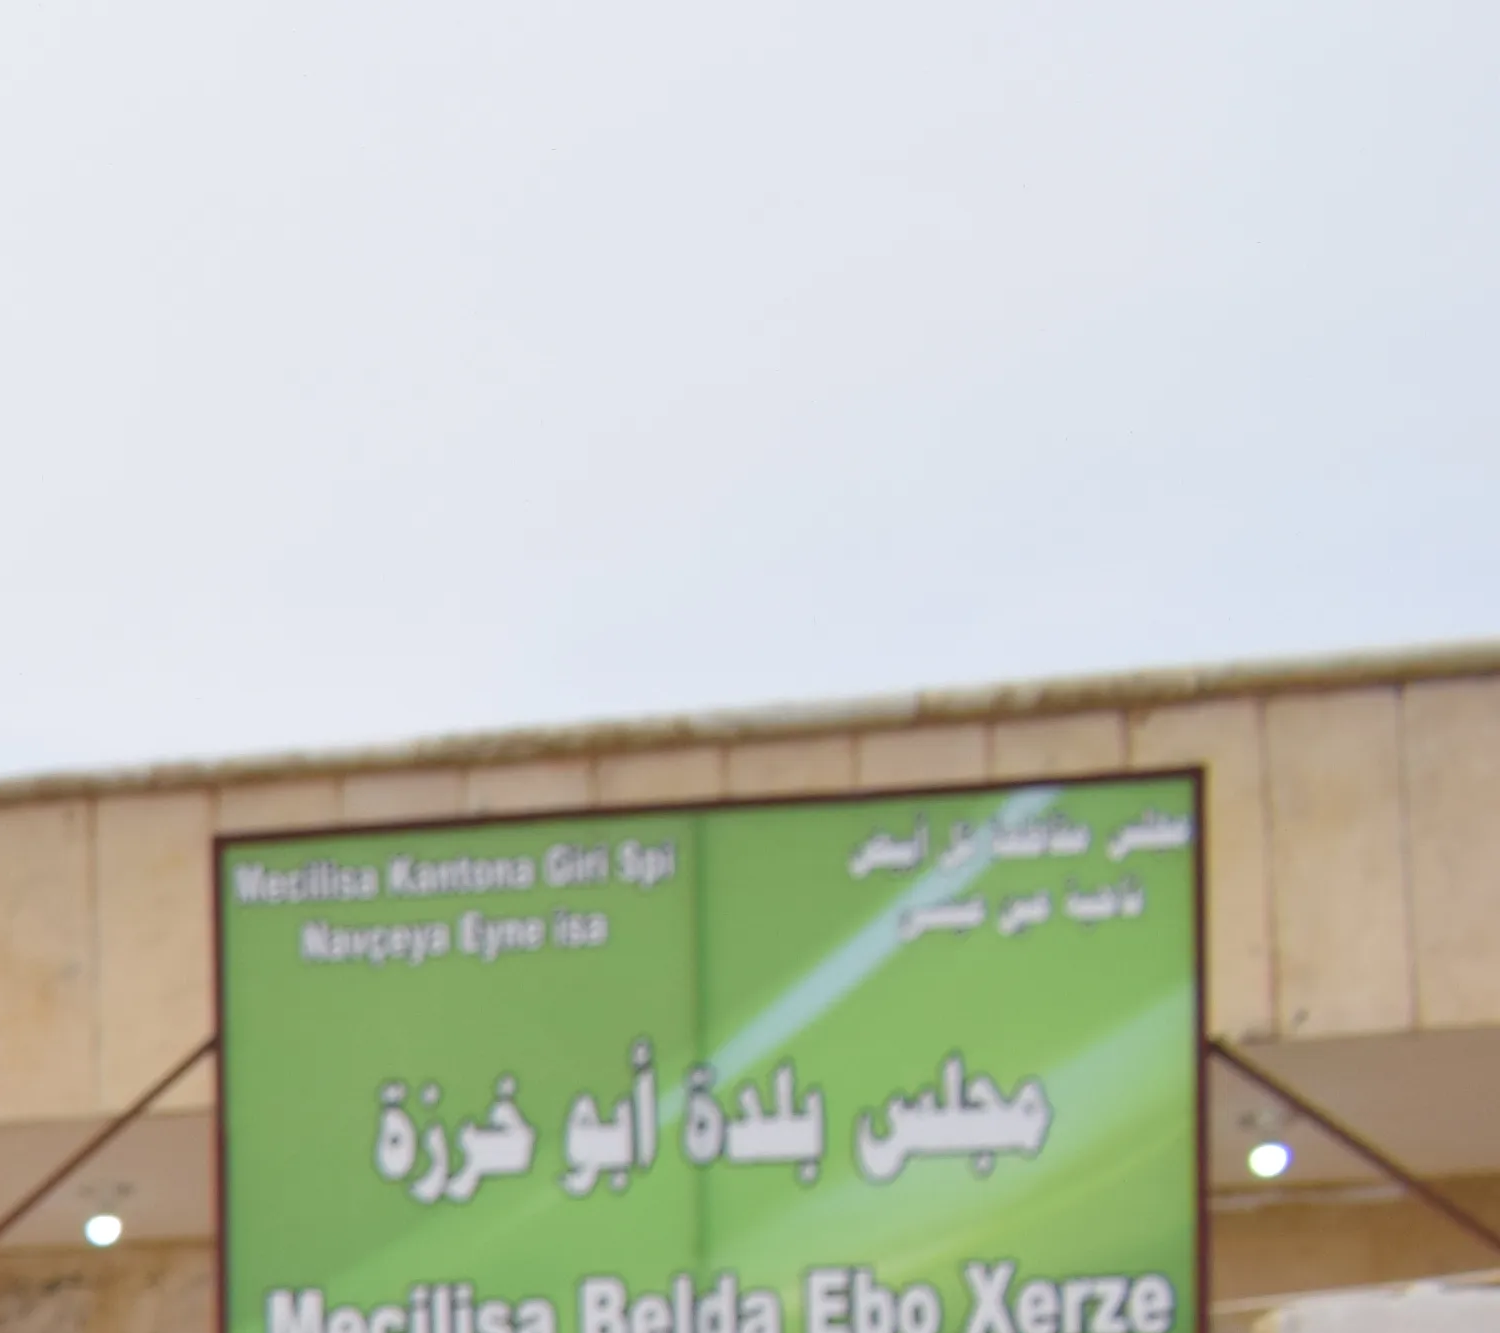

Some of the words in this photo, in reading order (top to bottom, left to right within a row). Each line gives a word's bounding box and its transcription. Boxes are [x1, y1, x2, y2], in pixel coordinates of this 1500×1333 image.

[233, 859, 379, 904] Mecilisa
[386, 852, 536, 896] Kantona
[457, 909, 546, 962] Eyne
[374, 1070, 536, 1202] خرزة
[559, 1038, 659, 1196] أبو
[682, 1060, 824, 1186] بلدة
[856, 1050, 1053, 1184] مجلس
